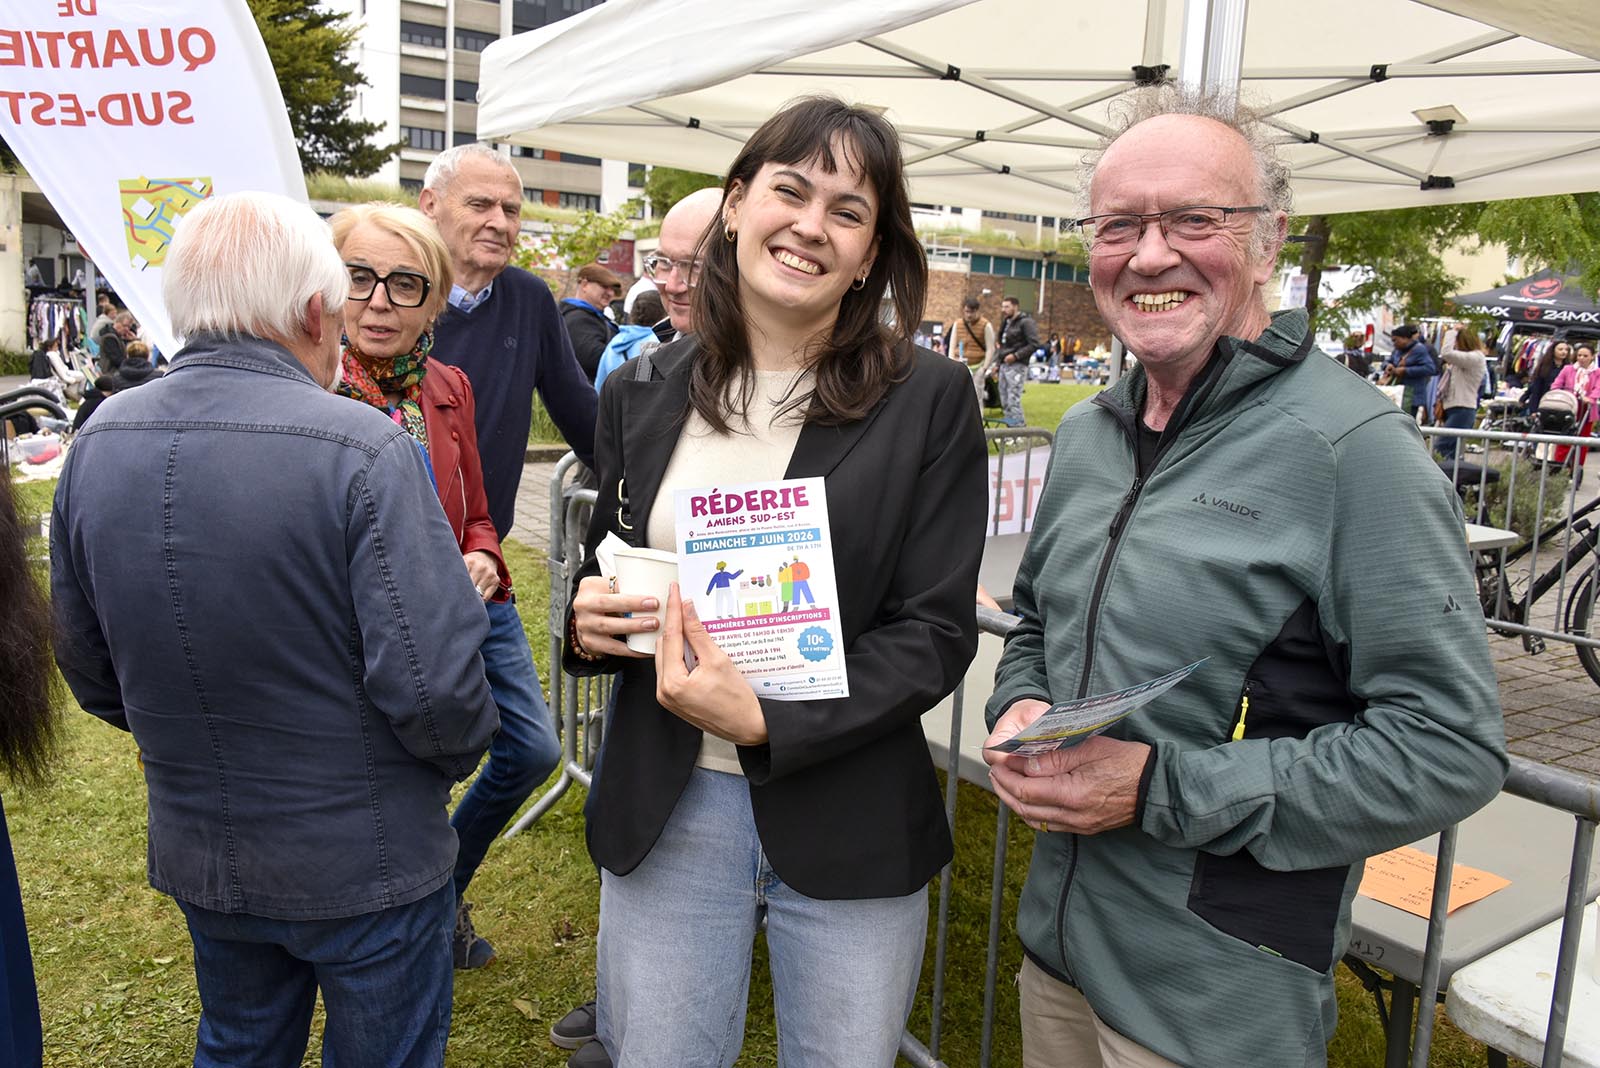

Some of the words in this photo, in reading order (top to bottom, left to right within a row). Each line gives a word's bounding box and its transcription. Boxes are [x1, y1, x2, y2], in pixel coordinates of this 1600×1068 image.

[1543, 310, 1600, 323] 24MX
[691, 486, 809, 518] RÉDERIE
[1211, 497, 1262, 520] VAUDE
[706, 515, 746, 528] AMIENS
[750, 511, 796, 523] SUD-EST
[692, 537, 748, 552] DIMANCHE
[750, 536, 756, 546] 7
[758, 533, 785, 545] JUIN
[787, 531, 814, 543] 2026
[708, 620, 745, 631] PREMIÈRES
[746, 617, 768, 627] DATES
[769, 612, 823, 623] D'INSCRIPTIONS
